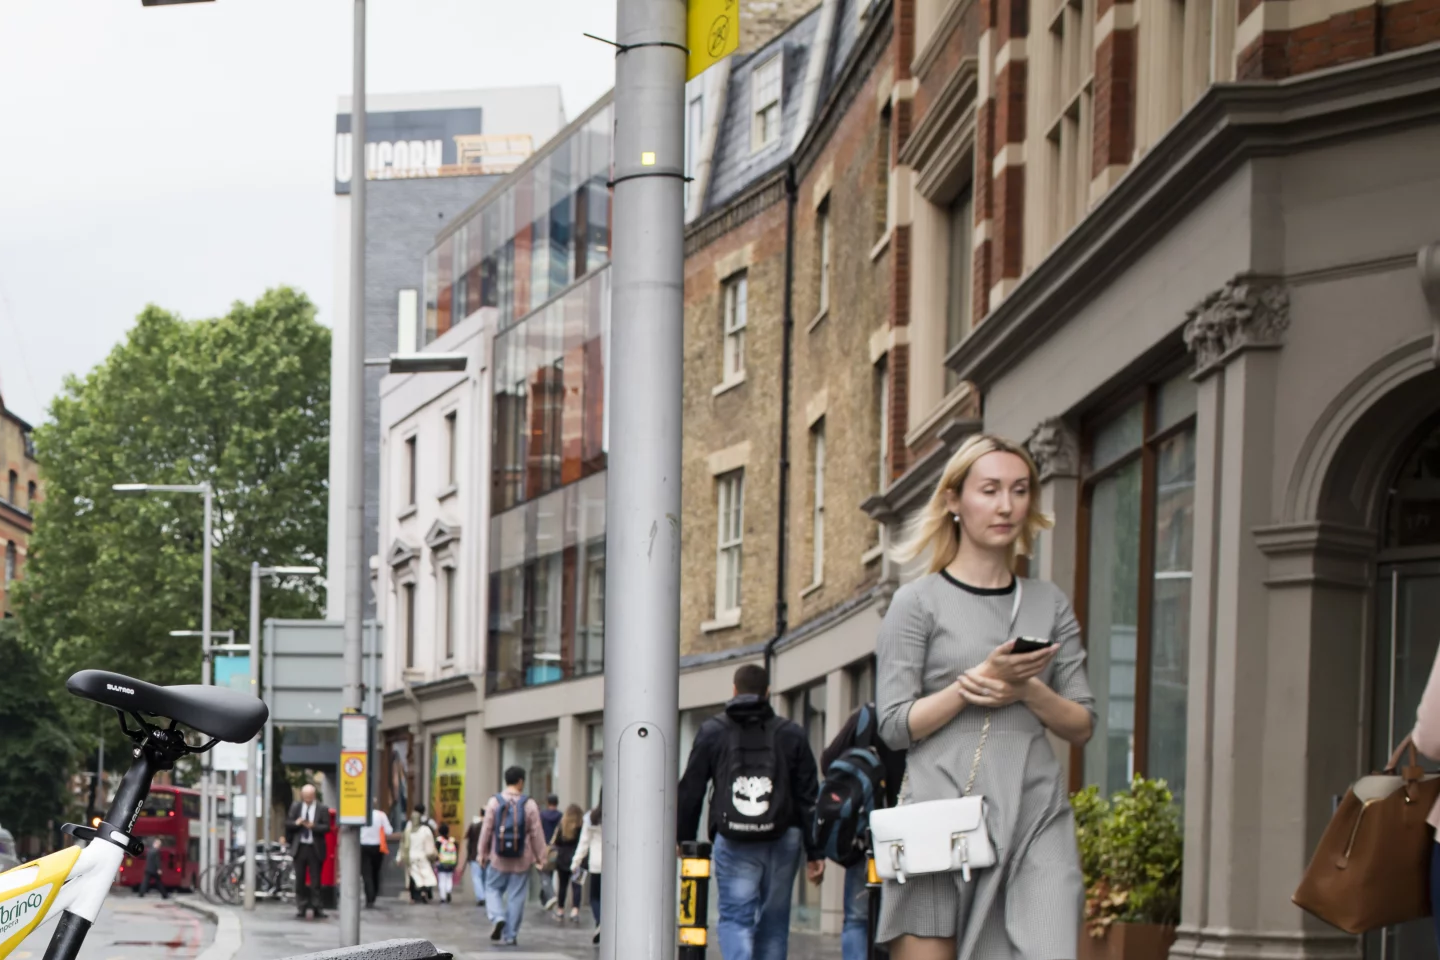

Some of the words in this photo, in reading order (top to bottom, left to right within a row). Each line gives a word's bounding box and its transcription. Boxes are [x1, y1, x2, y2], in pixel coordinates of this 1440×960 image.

[336, 132, 443, 181] UICORN
[106, 683, 135, 695] BULTACO
[125, 799, 144, 834] LTACO
